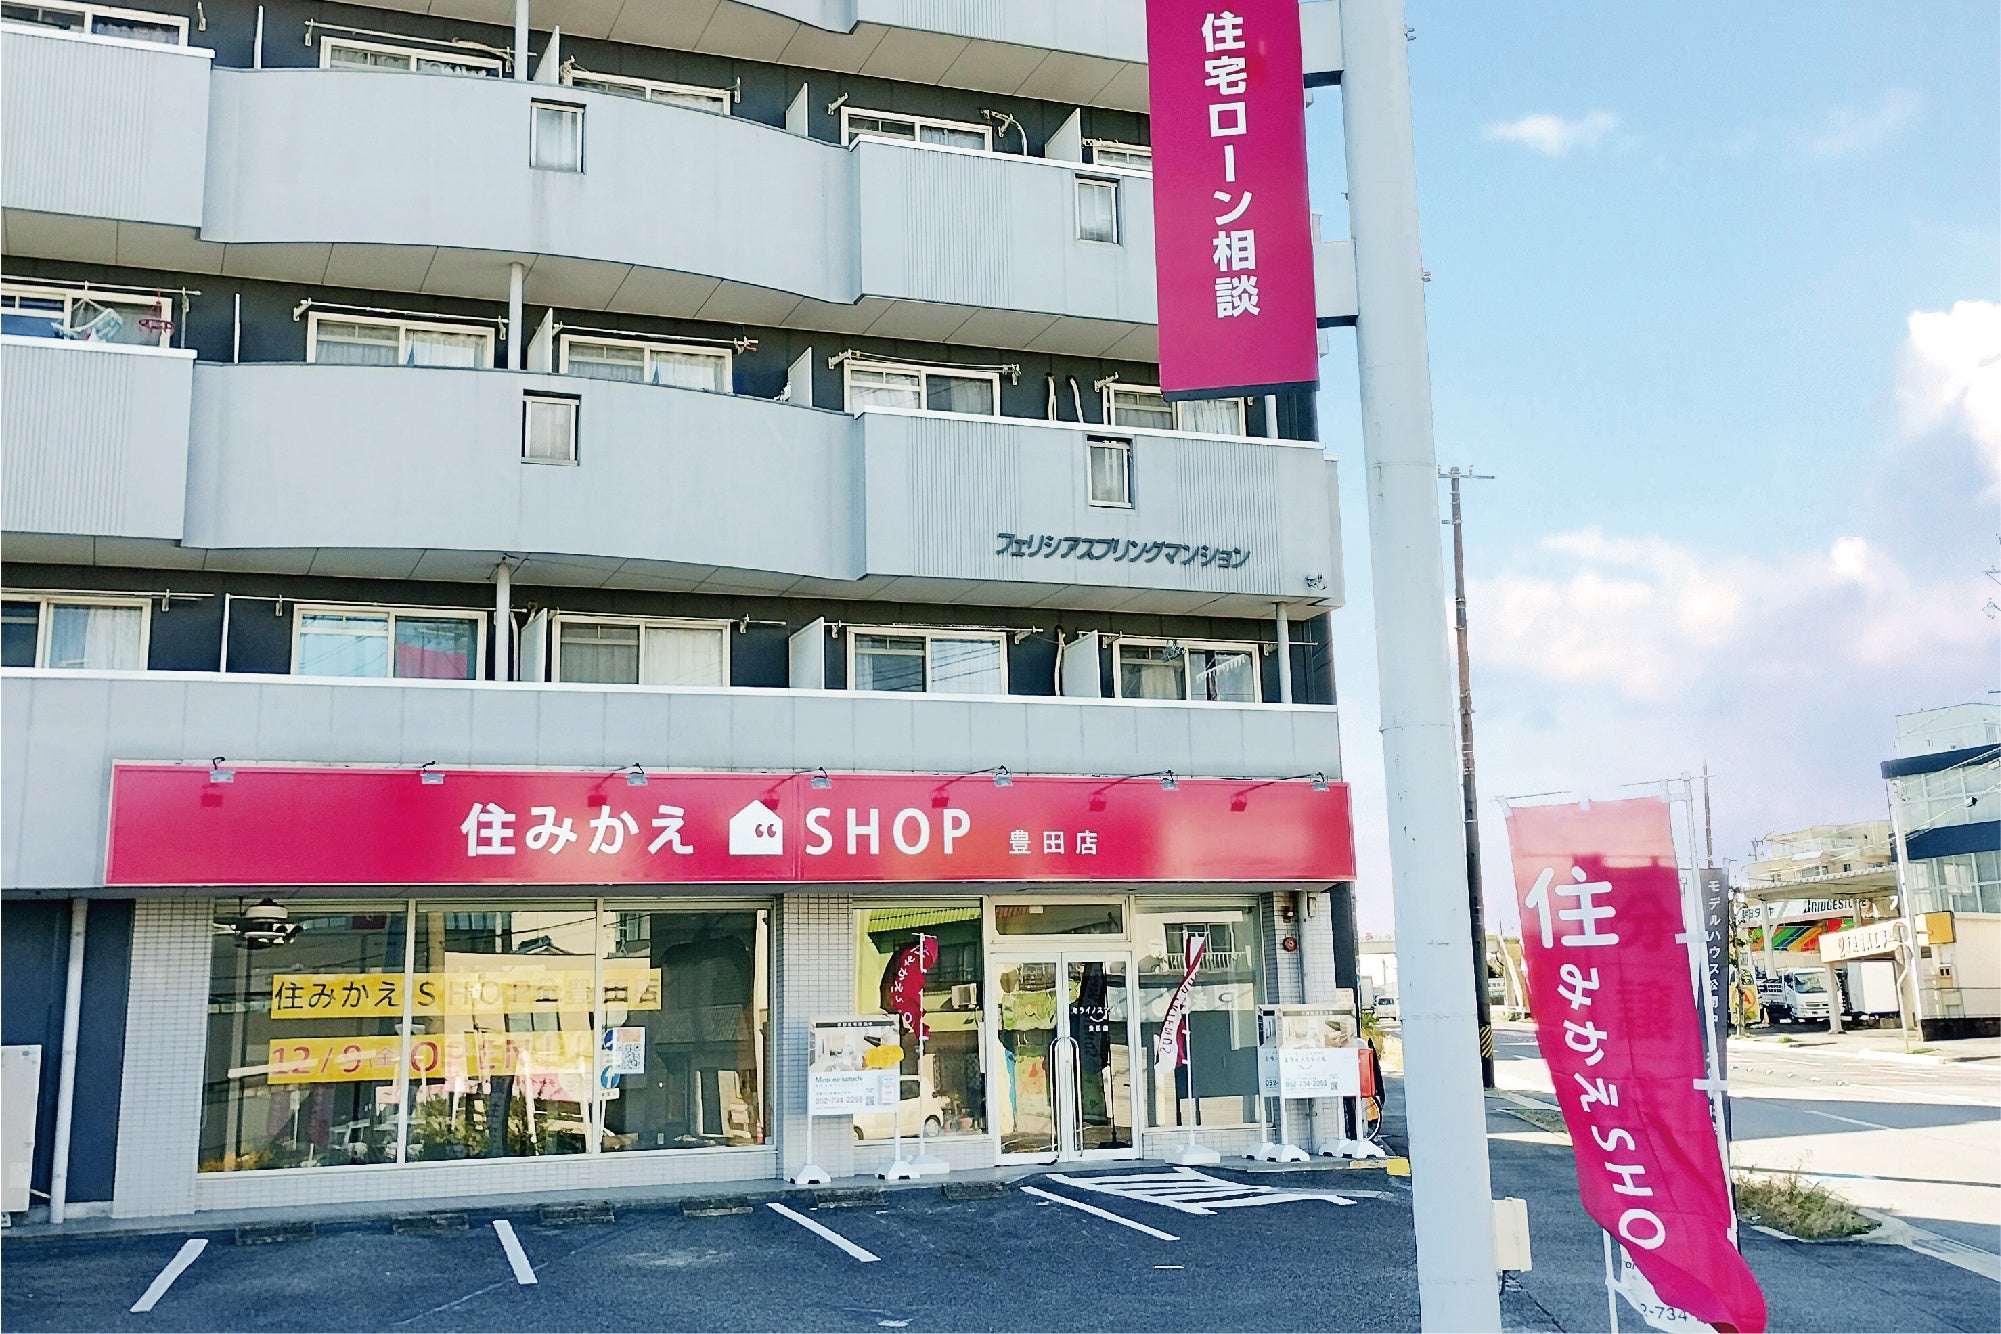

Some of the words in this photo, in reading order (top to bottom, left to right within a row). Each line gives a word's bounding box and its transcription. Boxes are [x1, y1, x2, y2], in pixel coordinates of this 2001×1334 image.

[1201, 10, 1260, 319] 住宅ローン相談
[459, 802, 694, 858] 住みかえ
[804, 806, 971, 855] SHOP
[1008, 829, 1098, 855] 豊田店
